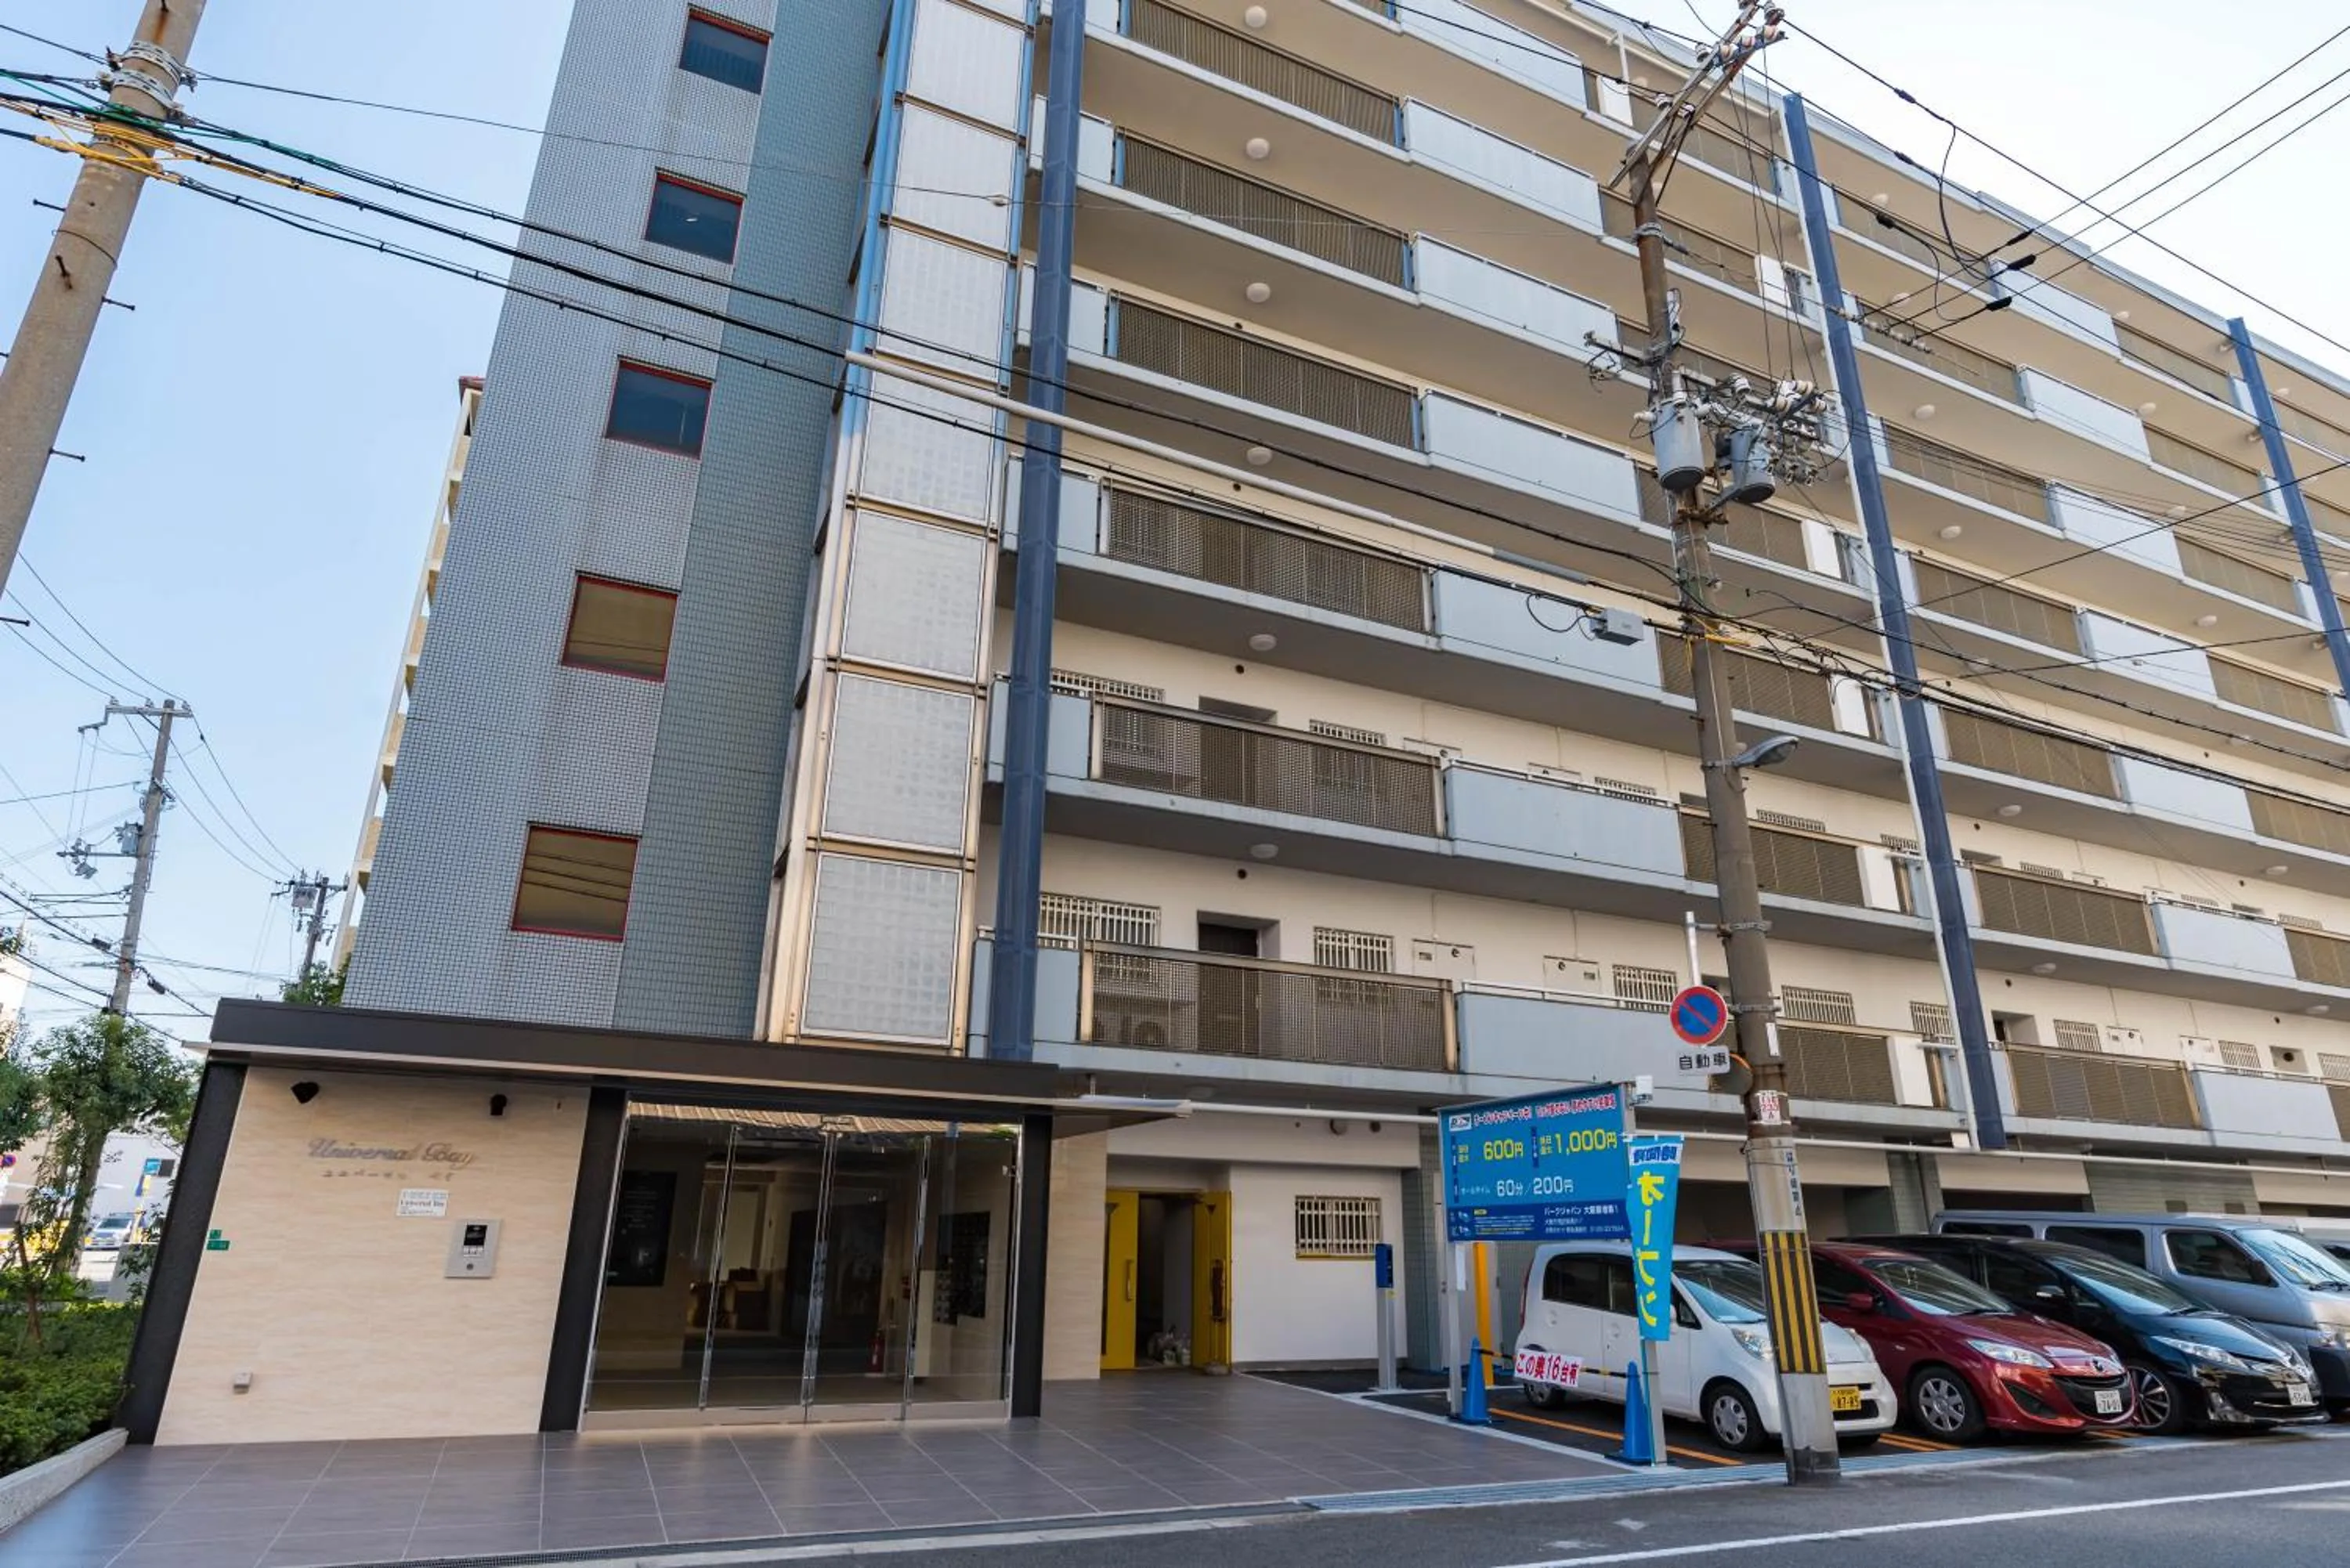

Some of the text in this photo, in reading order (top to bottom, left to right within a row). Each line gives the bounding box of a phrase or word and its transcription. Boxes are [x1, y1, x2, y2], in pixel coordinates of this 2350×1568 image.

[1679, 1053, 1728, 1070] 自動車
[308, 1138, 475, 1170] Universal Bay
[1484, 1139, 1524, 1162] 600円
[1555, 1129, 1618, 1157] 1,000円
[1496, 1179, 1523, 1198] 60分
[1533, 1176, 1574, 1195] 200円
[1636, 1170, 1665, 1328] オープン
